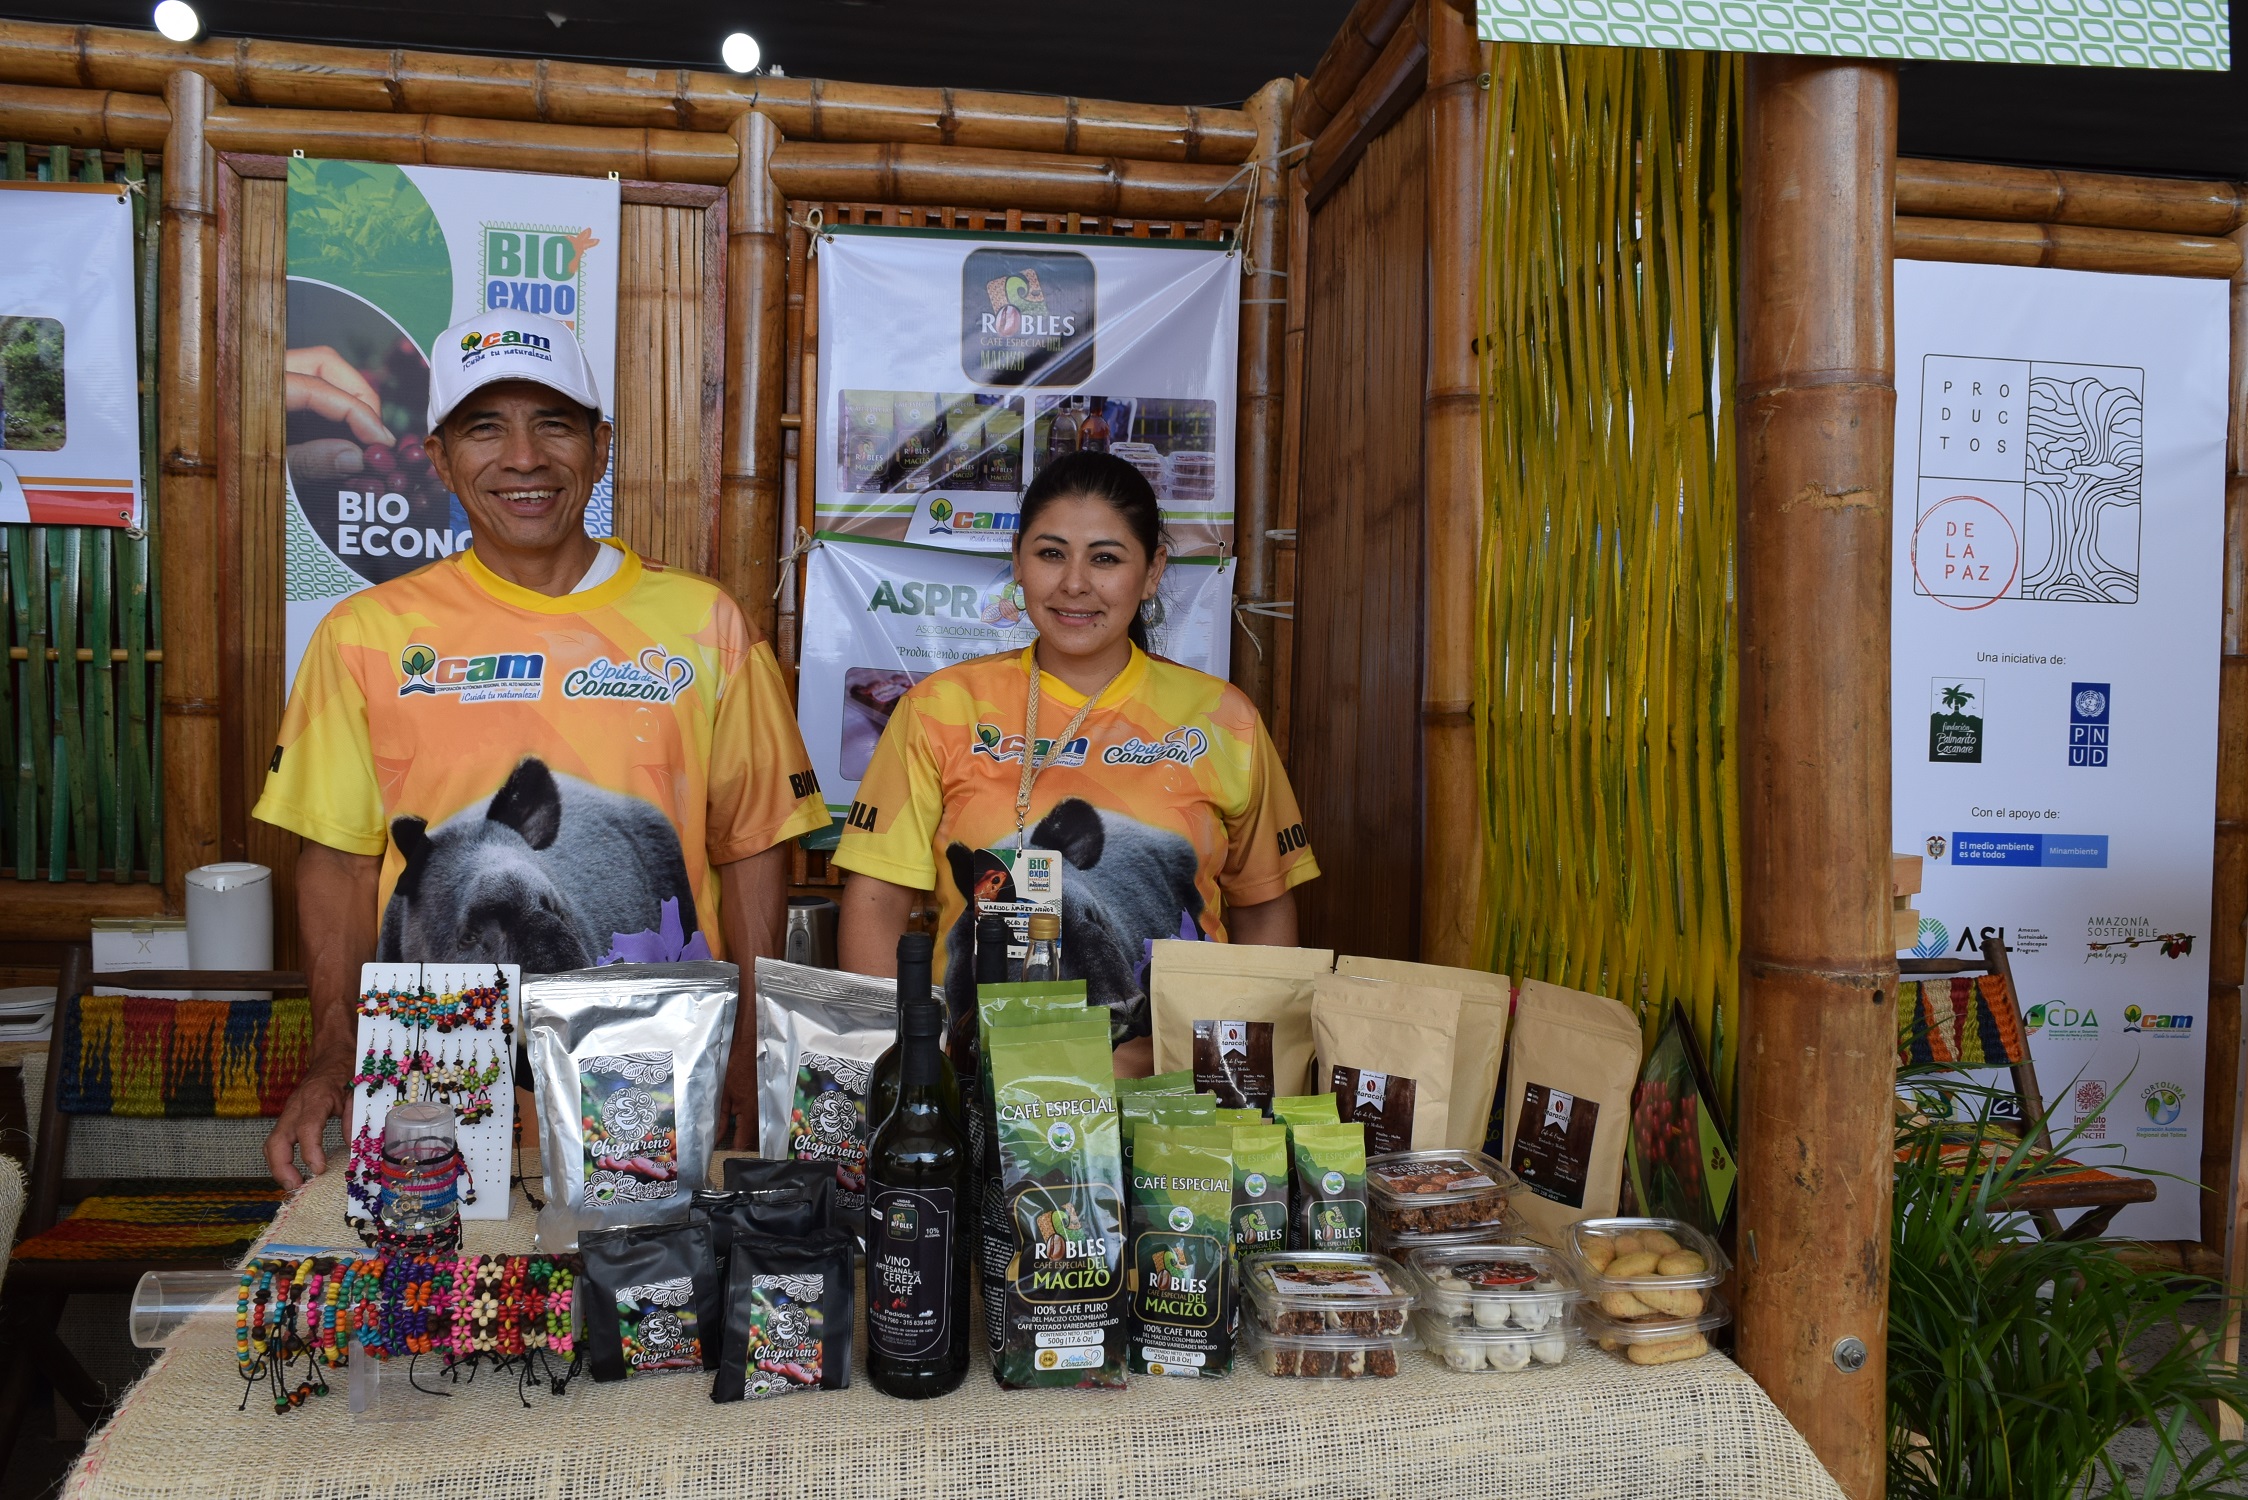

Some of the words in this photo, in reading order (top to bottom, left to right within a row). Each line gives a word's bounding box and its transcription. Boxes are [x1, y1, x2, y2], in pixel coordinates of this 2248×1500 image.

[488, 232, 579, 282] BIO
[487, 280, 576, 315] expo
[482, 331, 550, 349] cam
[1006, 338, 1046, 348] ESPECIAL
[1047, 337, 1063, 352] DEL
[981, 350, 1025, 371] MACIZO
[338, 490, 410, 524] BIO
[953, 512, 1020, 529] cam
[1946, 522, 1974, 538] DE
[1945, 544, 1974, 559] LA
[1945, 565, 1990, 581] PAZ
[867, 580, 980, 619] ASPR
[916, 625, 972, 636] ASOCIACIÓN
[973, 628, 985, 637] DE
[1977, 652, 1998, 663] Una
[2001, 653, 2047, 665] iniciativa
[2049, 654, 2066, 665] de:
[435, 654, 544, 684] cam
[589, 659, 640, 684] Opita
[640, 673, 653, 682] de
[564, 670, 671, 701] Corazón
[461, 690, 486, 702] ¡Cuida
[488, 690, 496, 699] tu
[497, 688, 541, 699] naturaleza!
[1936, 731, 1977, 744] Palmarito
[1124, 738, 1163, 754] Opita
[1104, 744, 1189, 765] Corazón
[1971, 806, 1993, 818] Con
[1996, 807, 2006, 818] el
[2008, 809, 2041, 821] apoyo
[2043, 808, 2060, 819] de:
[1276, 822, 1310, 856] BIO
[1959, 841, 1967, 849] El
[1969, 842, 1995, 850] medio
[1996, 842, 2034, 851] ambiente
[1982, 851, 2006, 859] todos
[2049, 847, 2098, 856] Minambiente
[1030, 859, 1048, 870] BIO
[1029, 870, 1048, 878] expo
[2088, 916, 2150, 926] AMAZONÍA
[2088, 927, 2159, 937] SOSTENIBLE
[2048, 1008, 2099, 1027] CDA
[2141, 1015, 2194, 1028] cam
[2140, 1081, 2187, 1100] CORTOLIMA
[1001, 1101, 1042, 1121] CAFÉ
[1045, 1098, 1116, 1118] ESPECIAL
[652, 1125, 671, 1136] Café
[1247, 1152, 1284, 1162] ESPECIAL
[1325, 1151, 1365, 1160] ESPECIAL
[1134, 1174, 1168, 1190] CAFÉ
[1172, 1177, 1232, 1192] ESPECIAL
[1347, 1238, 1361, 1246] DEL
[884, 1254, 911, 1267] VINO
[1054, 1261, 1087, 1269] ESPECIAL
[1087, 1257, 1108, 1271] DEL
[876, 1262, 913, 1275] ARTESANAL
[883, 1272, 922, 1285] CEREZA
[1033, 1269, 1111, 1289] MACIZO
[889, 1284, 913, 1295] CAFÉ
[1187, 1293, 1207, 1304] DEL
[1034, 1305, 1057, 1315] 100%
[1059, 1303, 1082, 1314] CAFÉ
[1084, 1302, 1108, 1313] PURO
[1145, 1296, 1208, 1317] MACIZO
[1034, 1323, 1062, 1331] TOSTADO
[1062, 1321, 1099, 1329] VARIEDADES
[1098, 1317, 1120, 1327] MOLIDO
[1043, 1315, 1067, 1323] MACIZO
[1068, 1312, 1108, 1322] COLOMBIANO
[1143, 1324, 1162, 1333] 100%
[1163, 1327, 1183, 1336] CAFÉ
[1185, 1329, 1208, 1338] PURO
[1047, 1337, 1064, 1345] 500g
[1065, 1336, 1081, 1344] (17.6
[1132, 1336, 1144, 1344] CAFÉ
[1144, 1338, 1167, 1346] TOSTADO
[1167, 1342, 1197, 1350] VARIEDADES
[1171, 1337, 1208, 1345] COLOMBIANO
[1153, 1354, 1169, 1362] 250g
